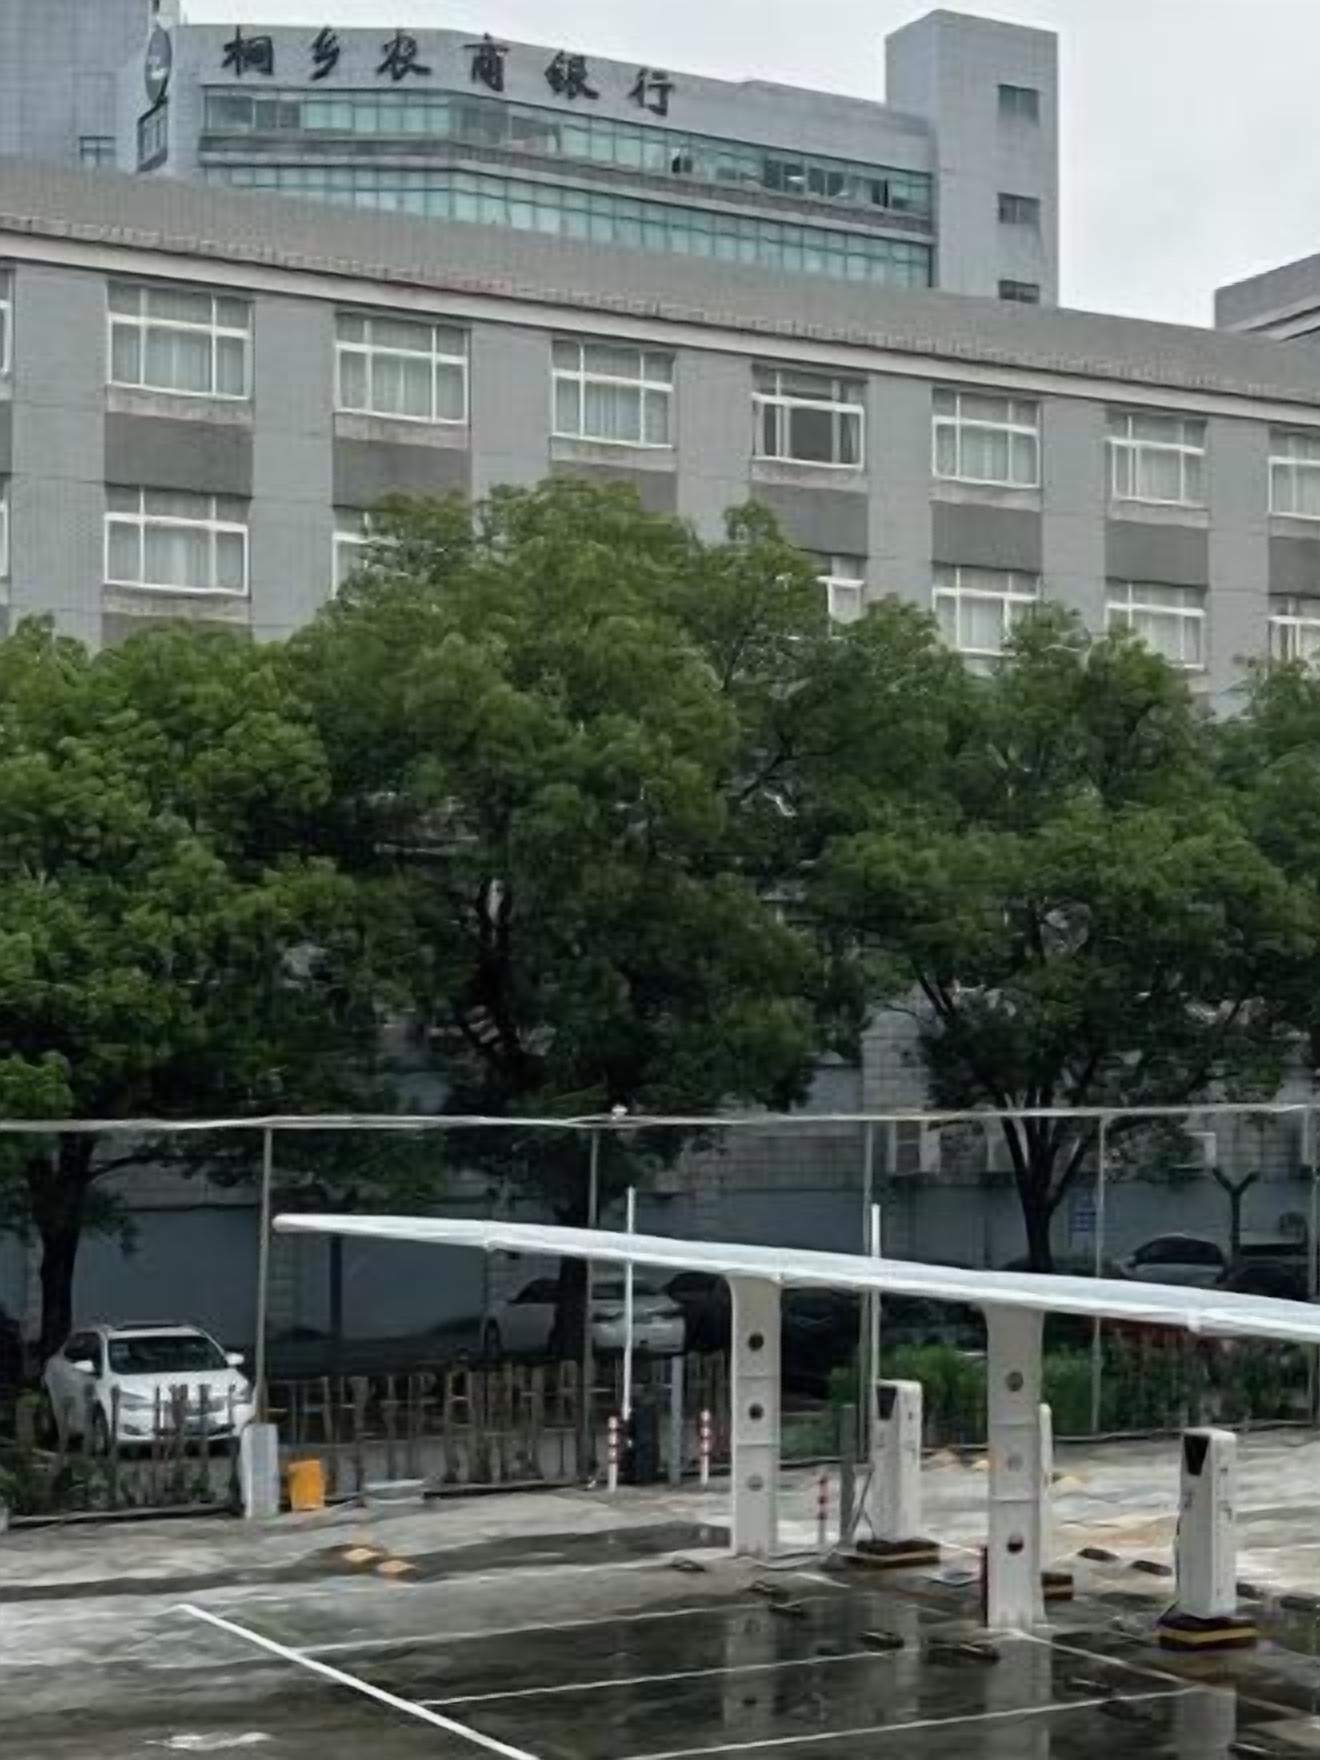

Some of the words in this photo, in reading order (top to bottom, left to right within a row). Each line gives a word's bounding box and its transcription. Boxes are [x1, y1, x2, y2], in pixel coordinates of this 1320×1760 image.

[222, 26, 675, 117] 桐乡农商银行
